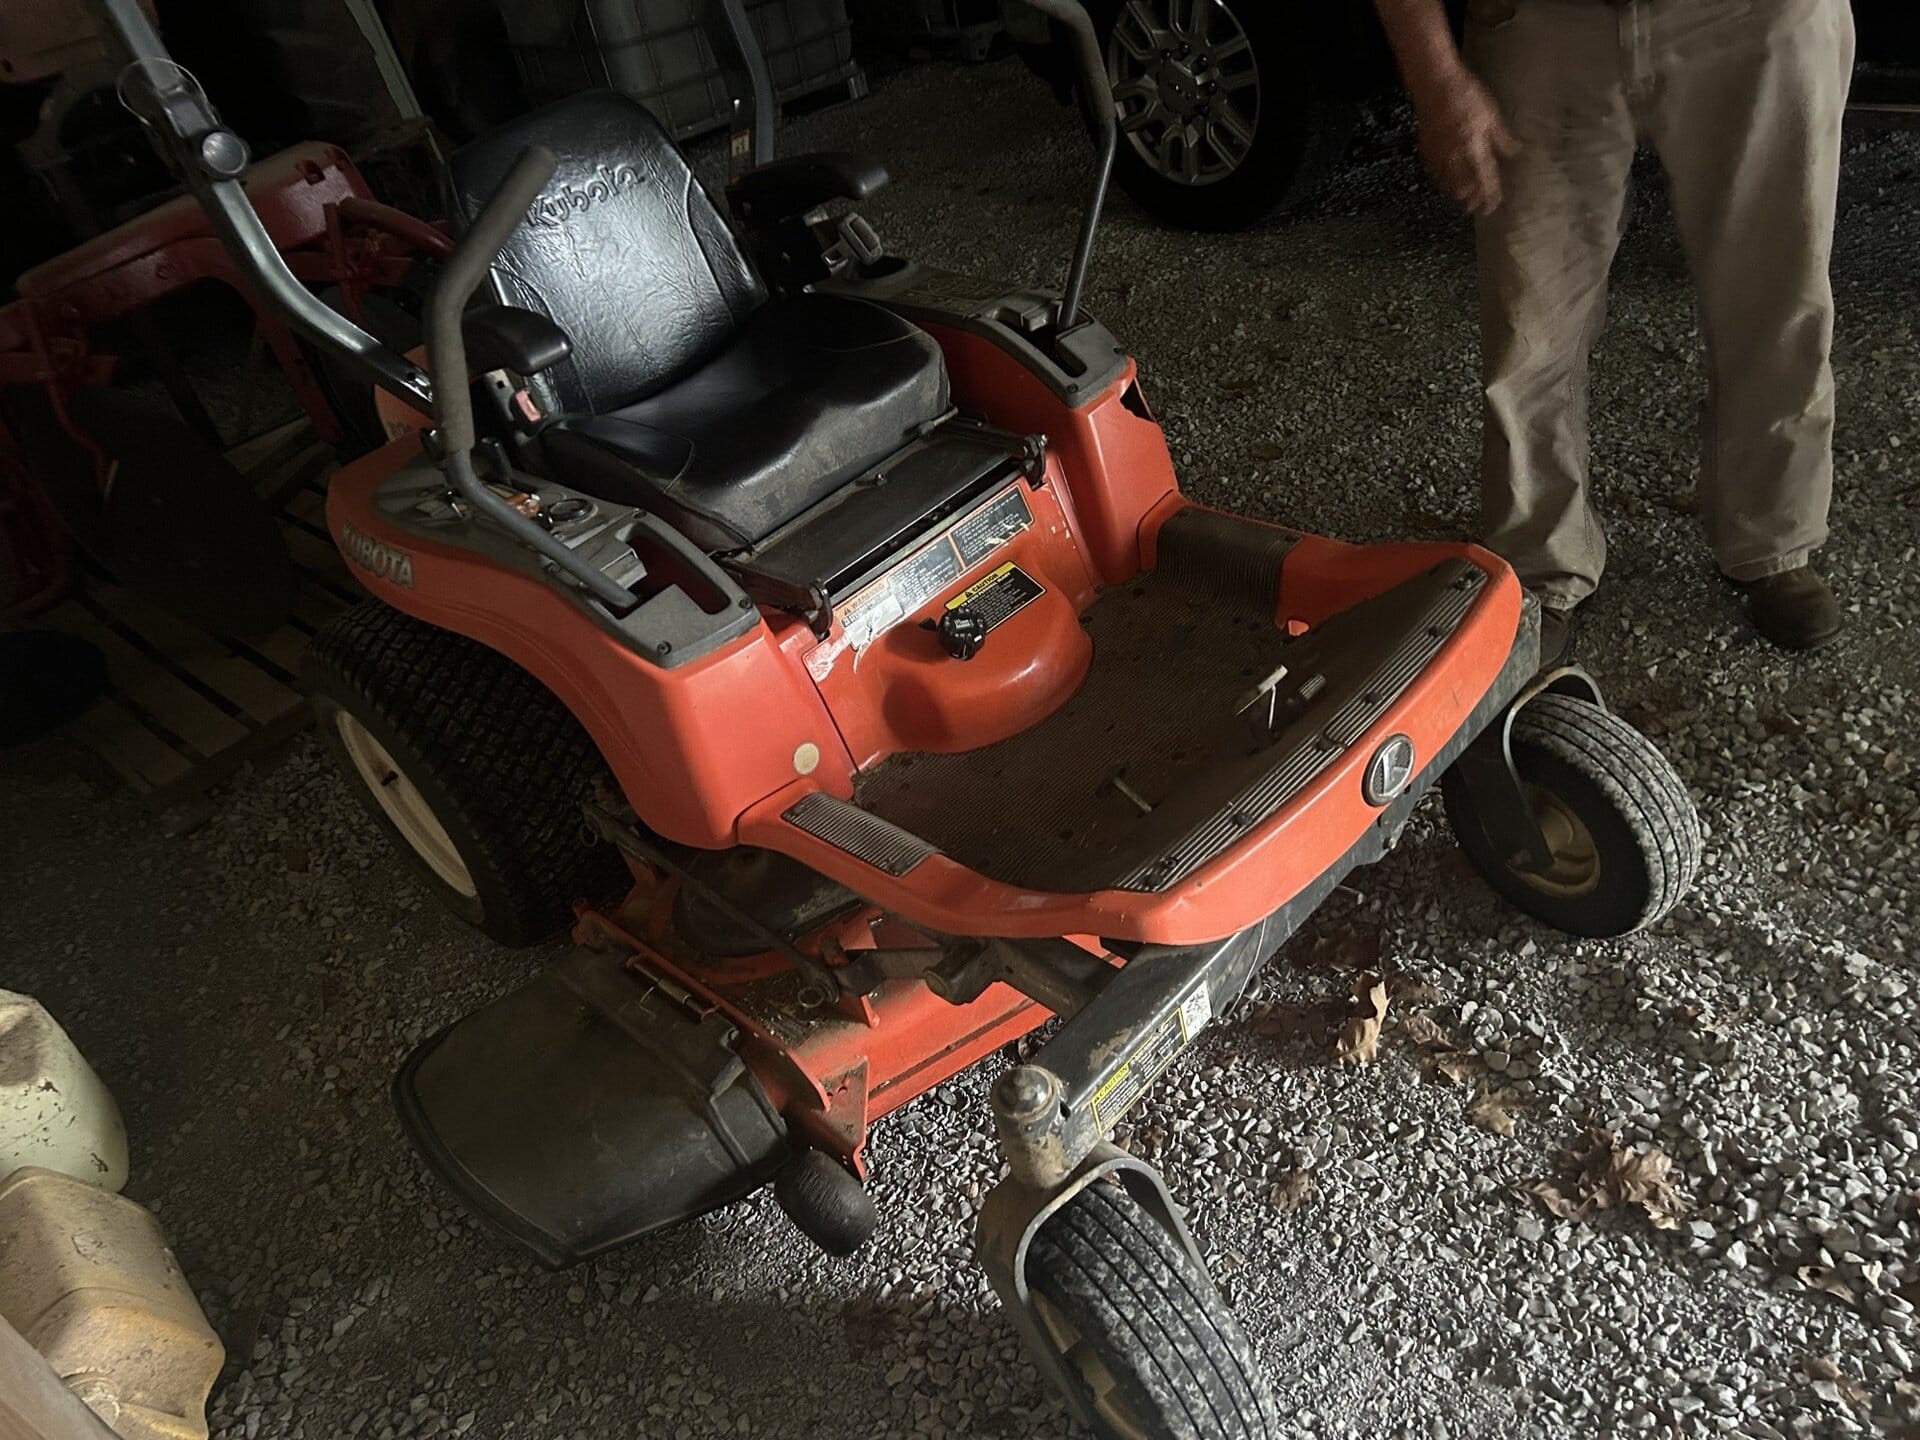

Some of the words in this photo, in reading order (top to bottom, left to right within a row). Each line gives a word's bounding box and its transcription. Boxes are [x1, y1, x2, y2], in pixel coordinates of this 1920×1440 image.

[525, 163, 645, 228] Kubota
[342, 520, 415, 589] KUBOTA
[972, 573, 999, 593] CAUTION
[1099, 1066, 1128, 1097] CAUTION
